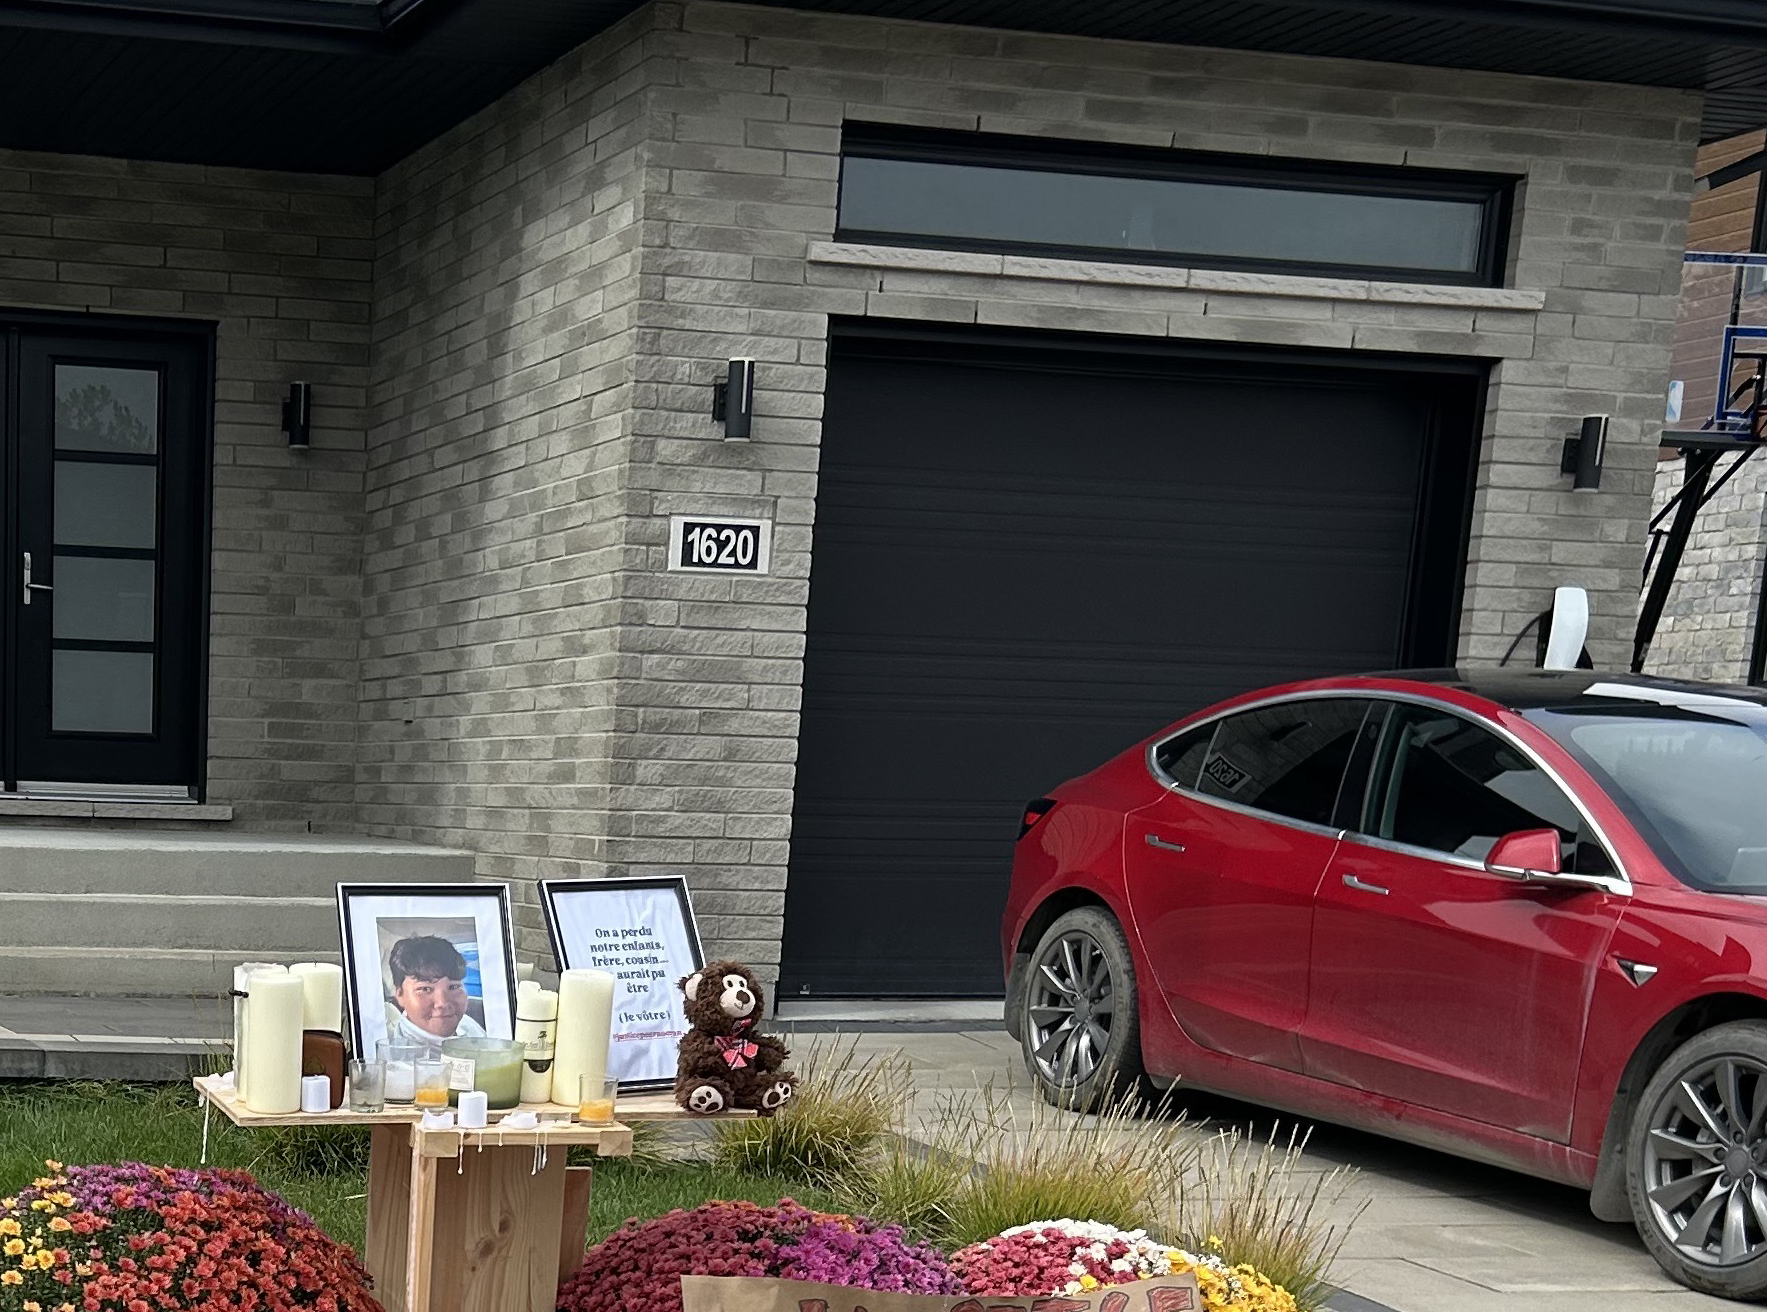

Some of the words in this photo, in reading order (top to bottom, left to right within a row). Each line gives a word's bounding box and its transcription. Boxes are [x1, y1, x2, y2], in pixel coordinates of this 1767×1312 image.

[687, 527, 754, 566] 1620
[595, 928, 610, 938] On
[621, 926, 652, 939] perdu
[590, 943, 620, 953] notre
[617, 968, 650, 979] aurait
[651, 969, 665, 981] pu
[627, 982, 649, 993] être
